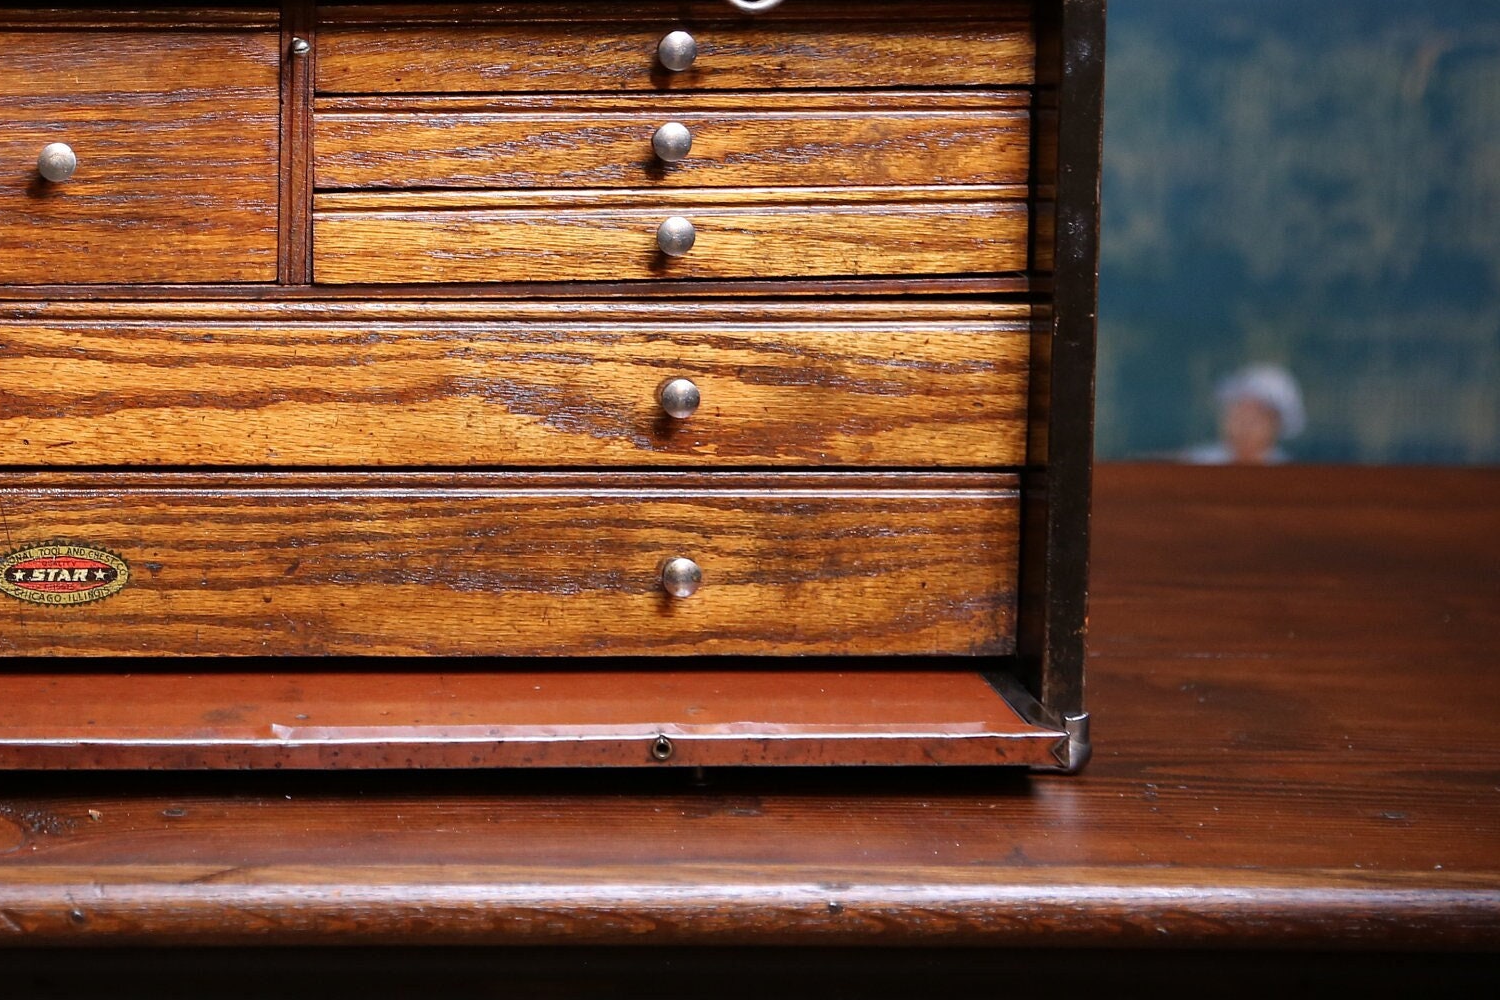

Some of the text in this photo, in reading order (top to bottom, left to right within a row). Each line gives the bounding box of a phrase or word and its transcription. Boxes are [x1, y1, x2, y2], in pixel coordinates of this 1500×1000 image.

[39, 547, 62, 557] TOOL
[66, 547, 86, 557] AND
[88, 550, 120, 565] CHEST
[30, 568, 88, 582] STAR
[14, 588, 110, 603] CHICAGO ILLINOIS
